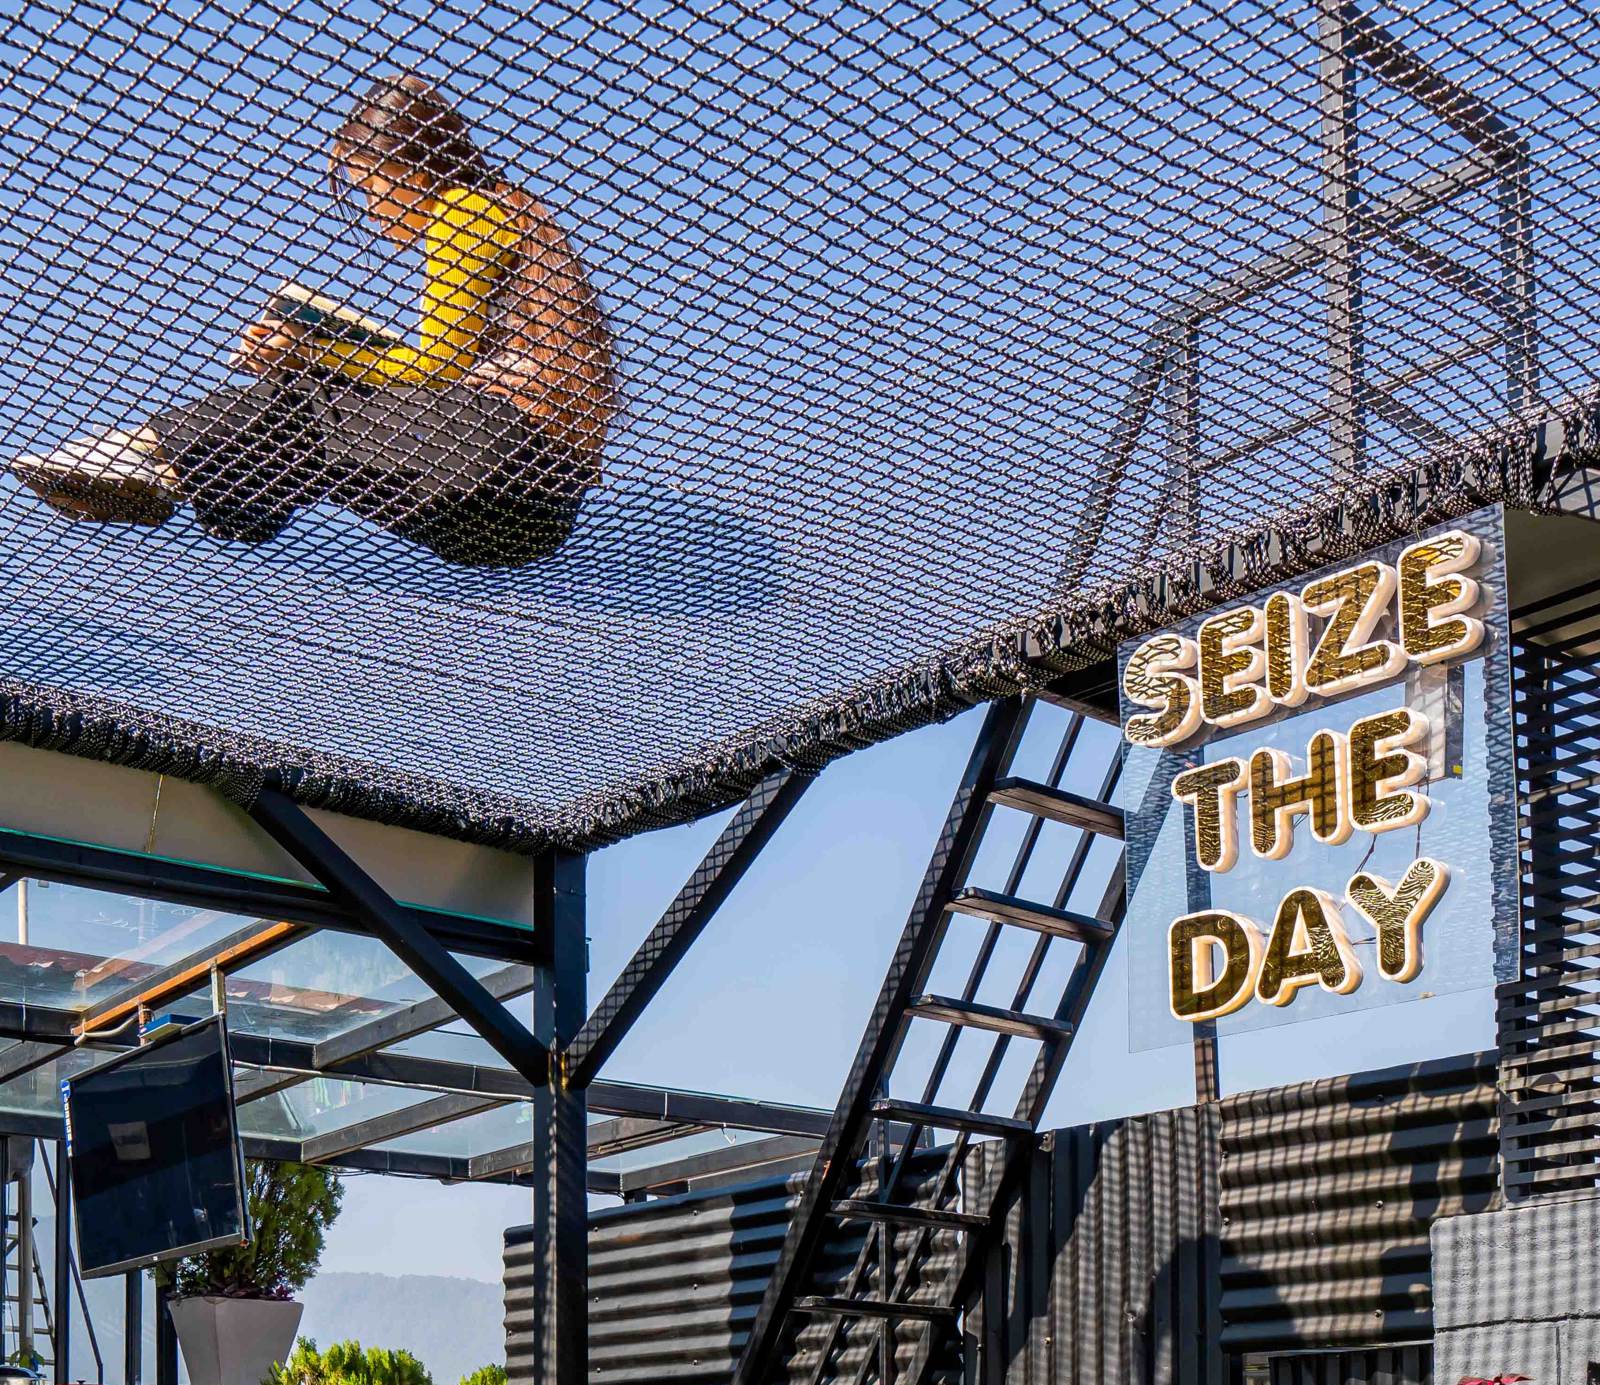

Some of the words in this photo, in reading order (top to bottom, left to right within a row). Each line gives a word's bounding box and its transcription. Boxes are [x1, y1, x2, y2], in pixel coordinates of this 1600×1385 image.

[1122, 529, 1486, 748] SEIZE
[1171, 707, 1431, 873] THE
[1167, 856, 1451, 1022] DAY
